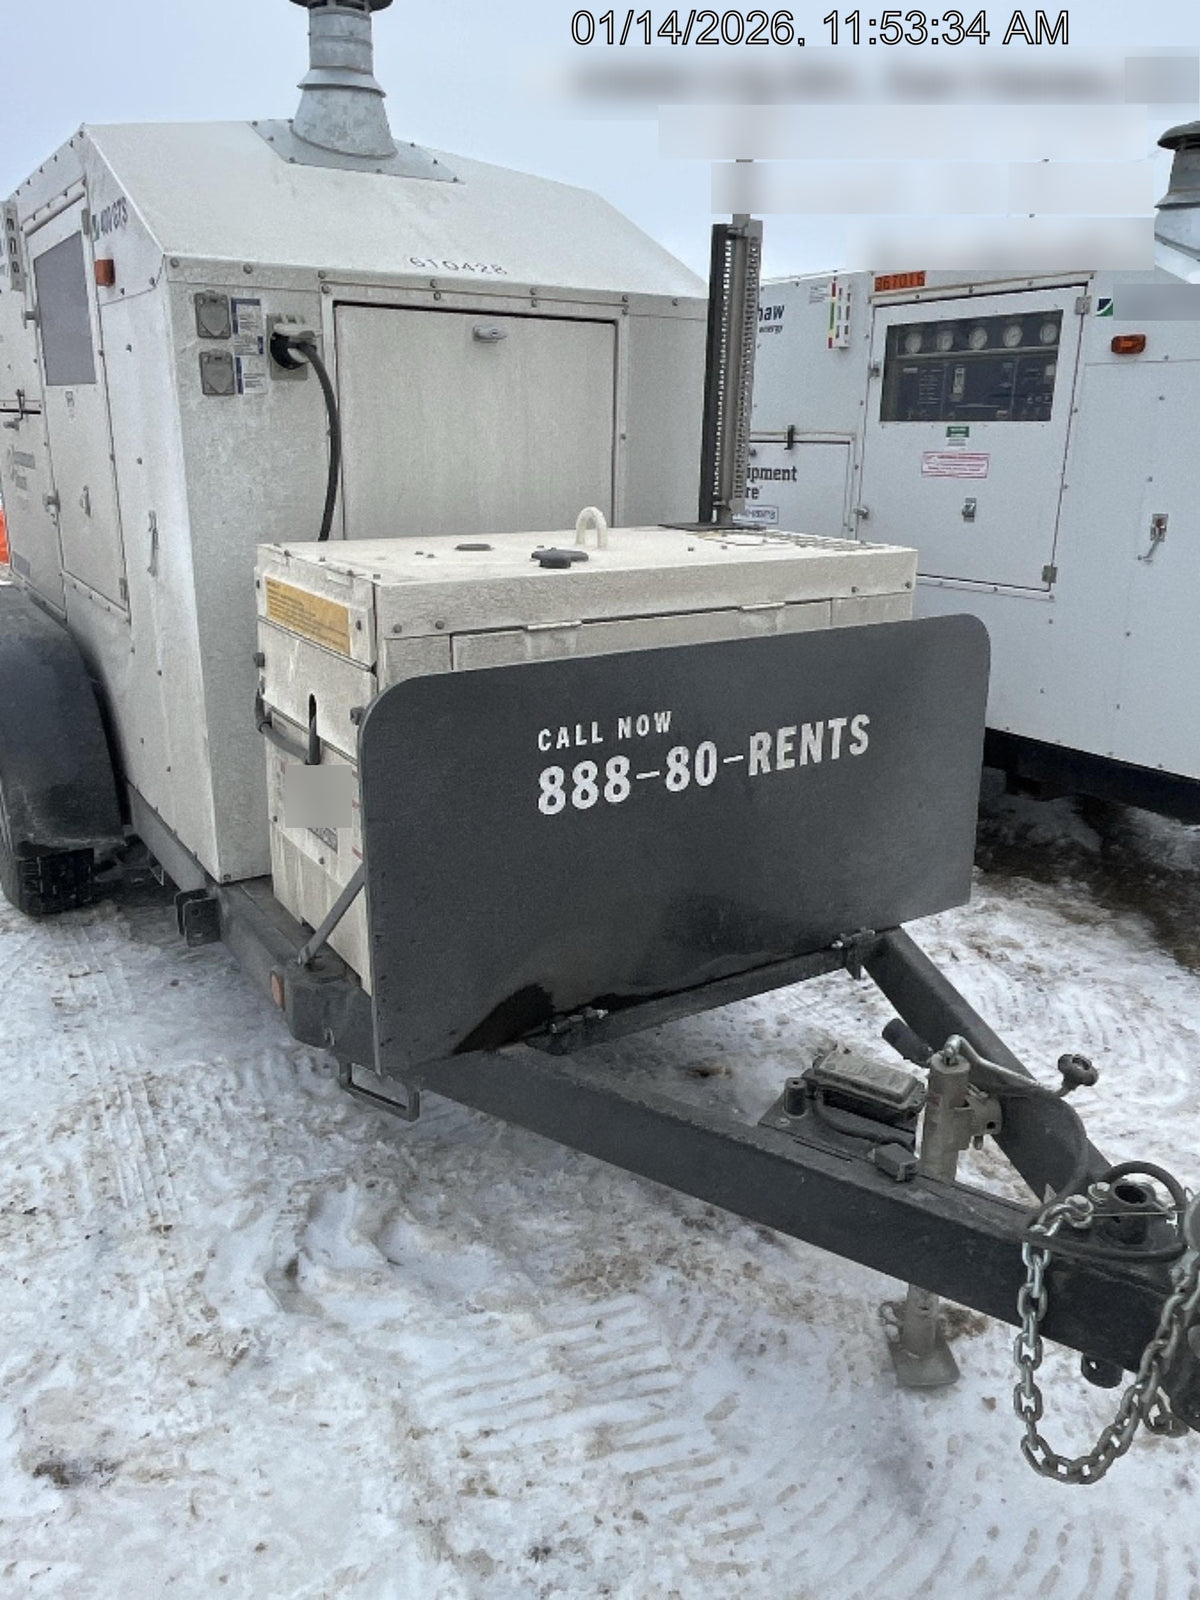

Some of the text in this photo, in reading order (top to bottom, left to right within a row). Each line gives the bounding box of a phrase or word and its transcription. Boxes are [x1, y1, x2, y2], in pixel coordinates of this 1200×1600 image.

[537, 710, 673, 751] CALL NOW
[537, 713, 871, 816] 888-80-RENTS
